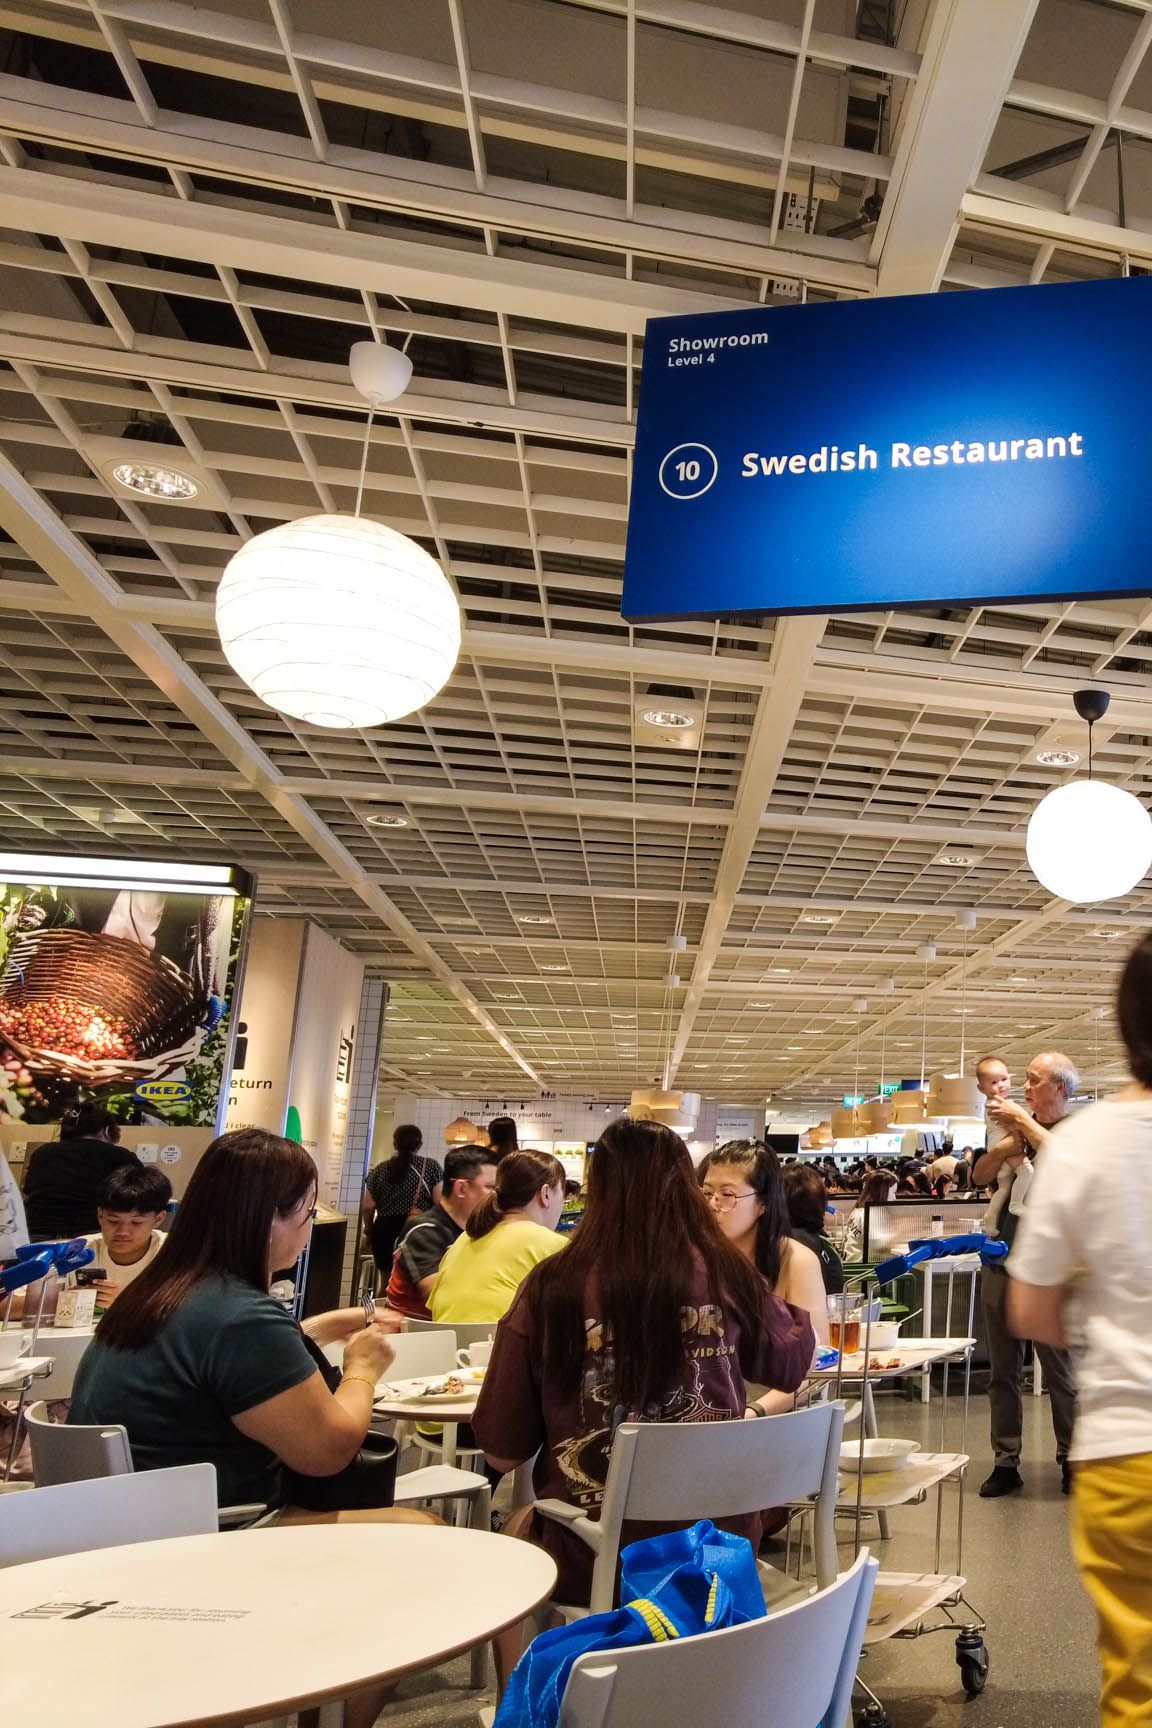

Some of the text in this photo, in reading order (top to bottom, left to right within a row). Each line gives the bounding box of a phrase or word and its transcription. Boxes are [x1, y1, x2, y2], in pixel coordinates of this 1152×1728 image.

[668, 332, 769, 352] Showroom
[667, 352, 716, 367] Level 4
[741, 432, 1083, 477] Swedish Restaurant
[675, 460, 700, 481] 10
[141, 1086, 187, 1095] IKEA
[229, 1079, 273, 1089] eturn
